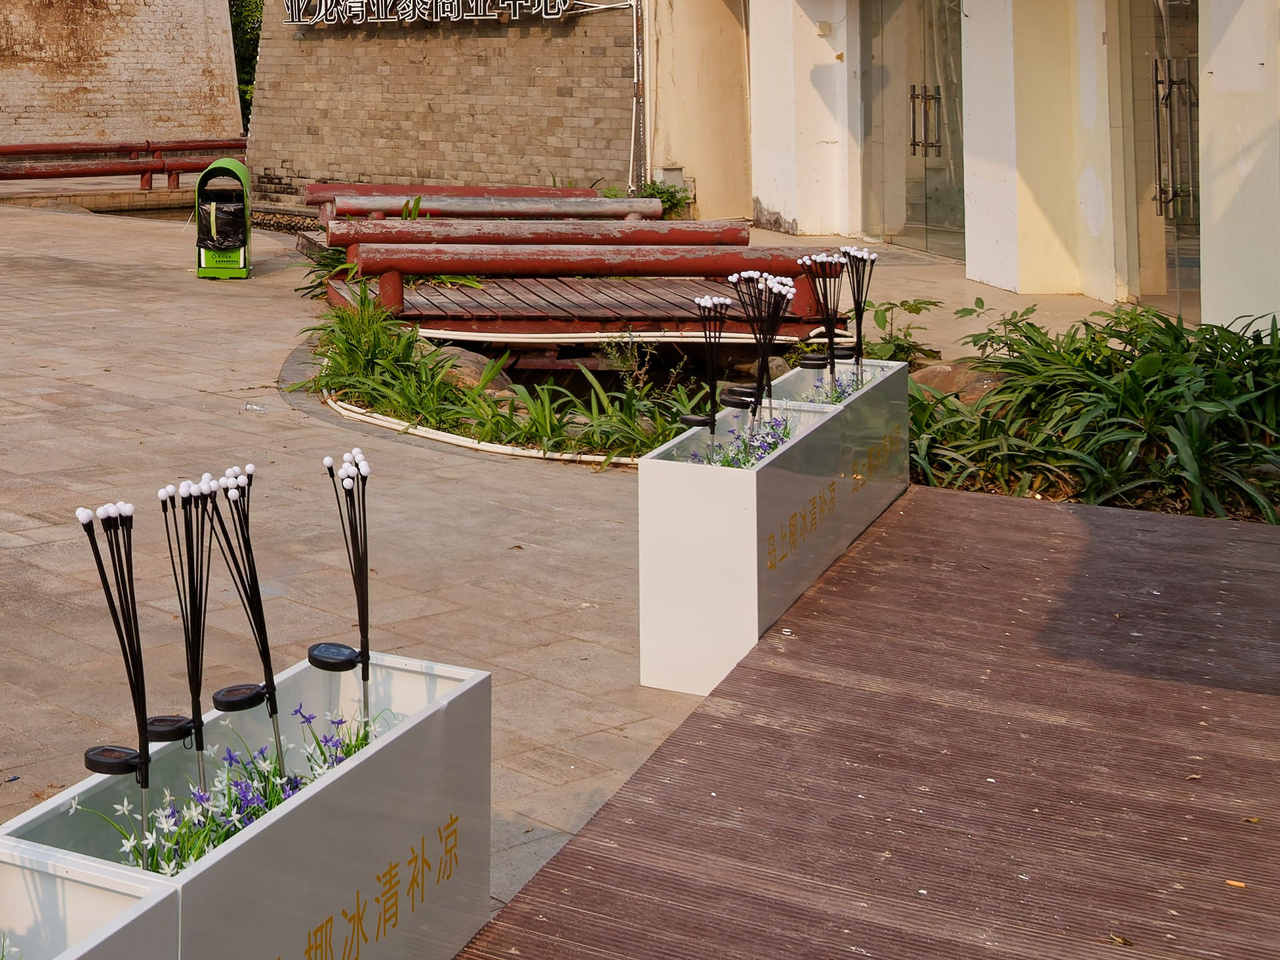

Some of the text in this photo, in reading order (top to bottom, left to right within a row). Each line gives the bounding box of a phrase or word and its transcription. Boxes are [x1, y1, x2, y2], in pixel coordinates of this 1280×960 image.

[274, 813, 459, 960] 椰冰清补凉
